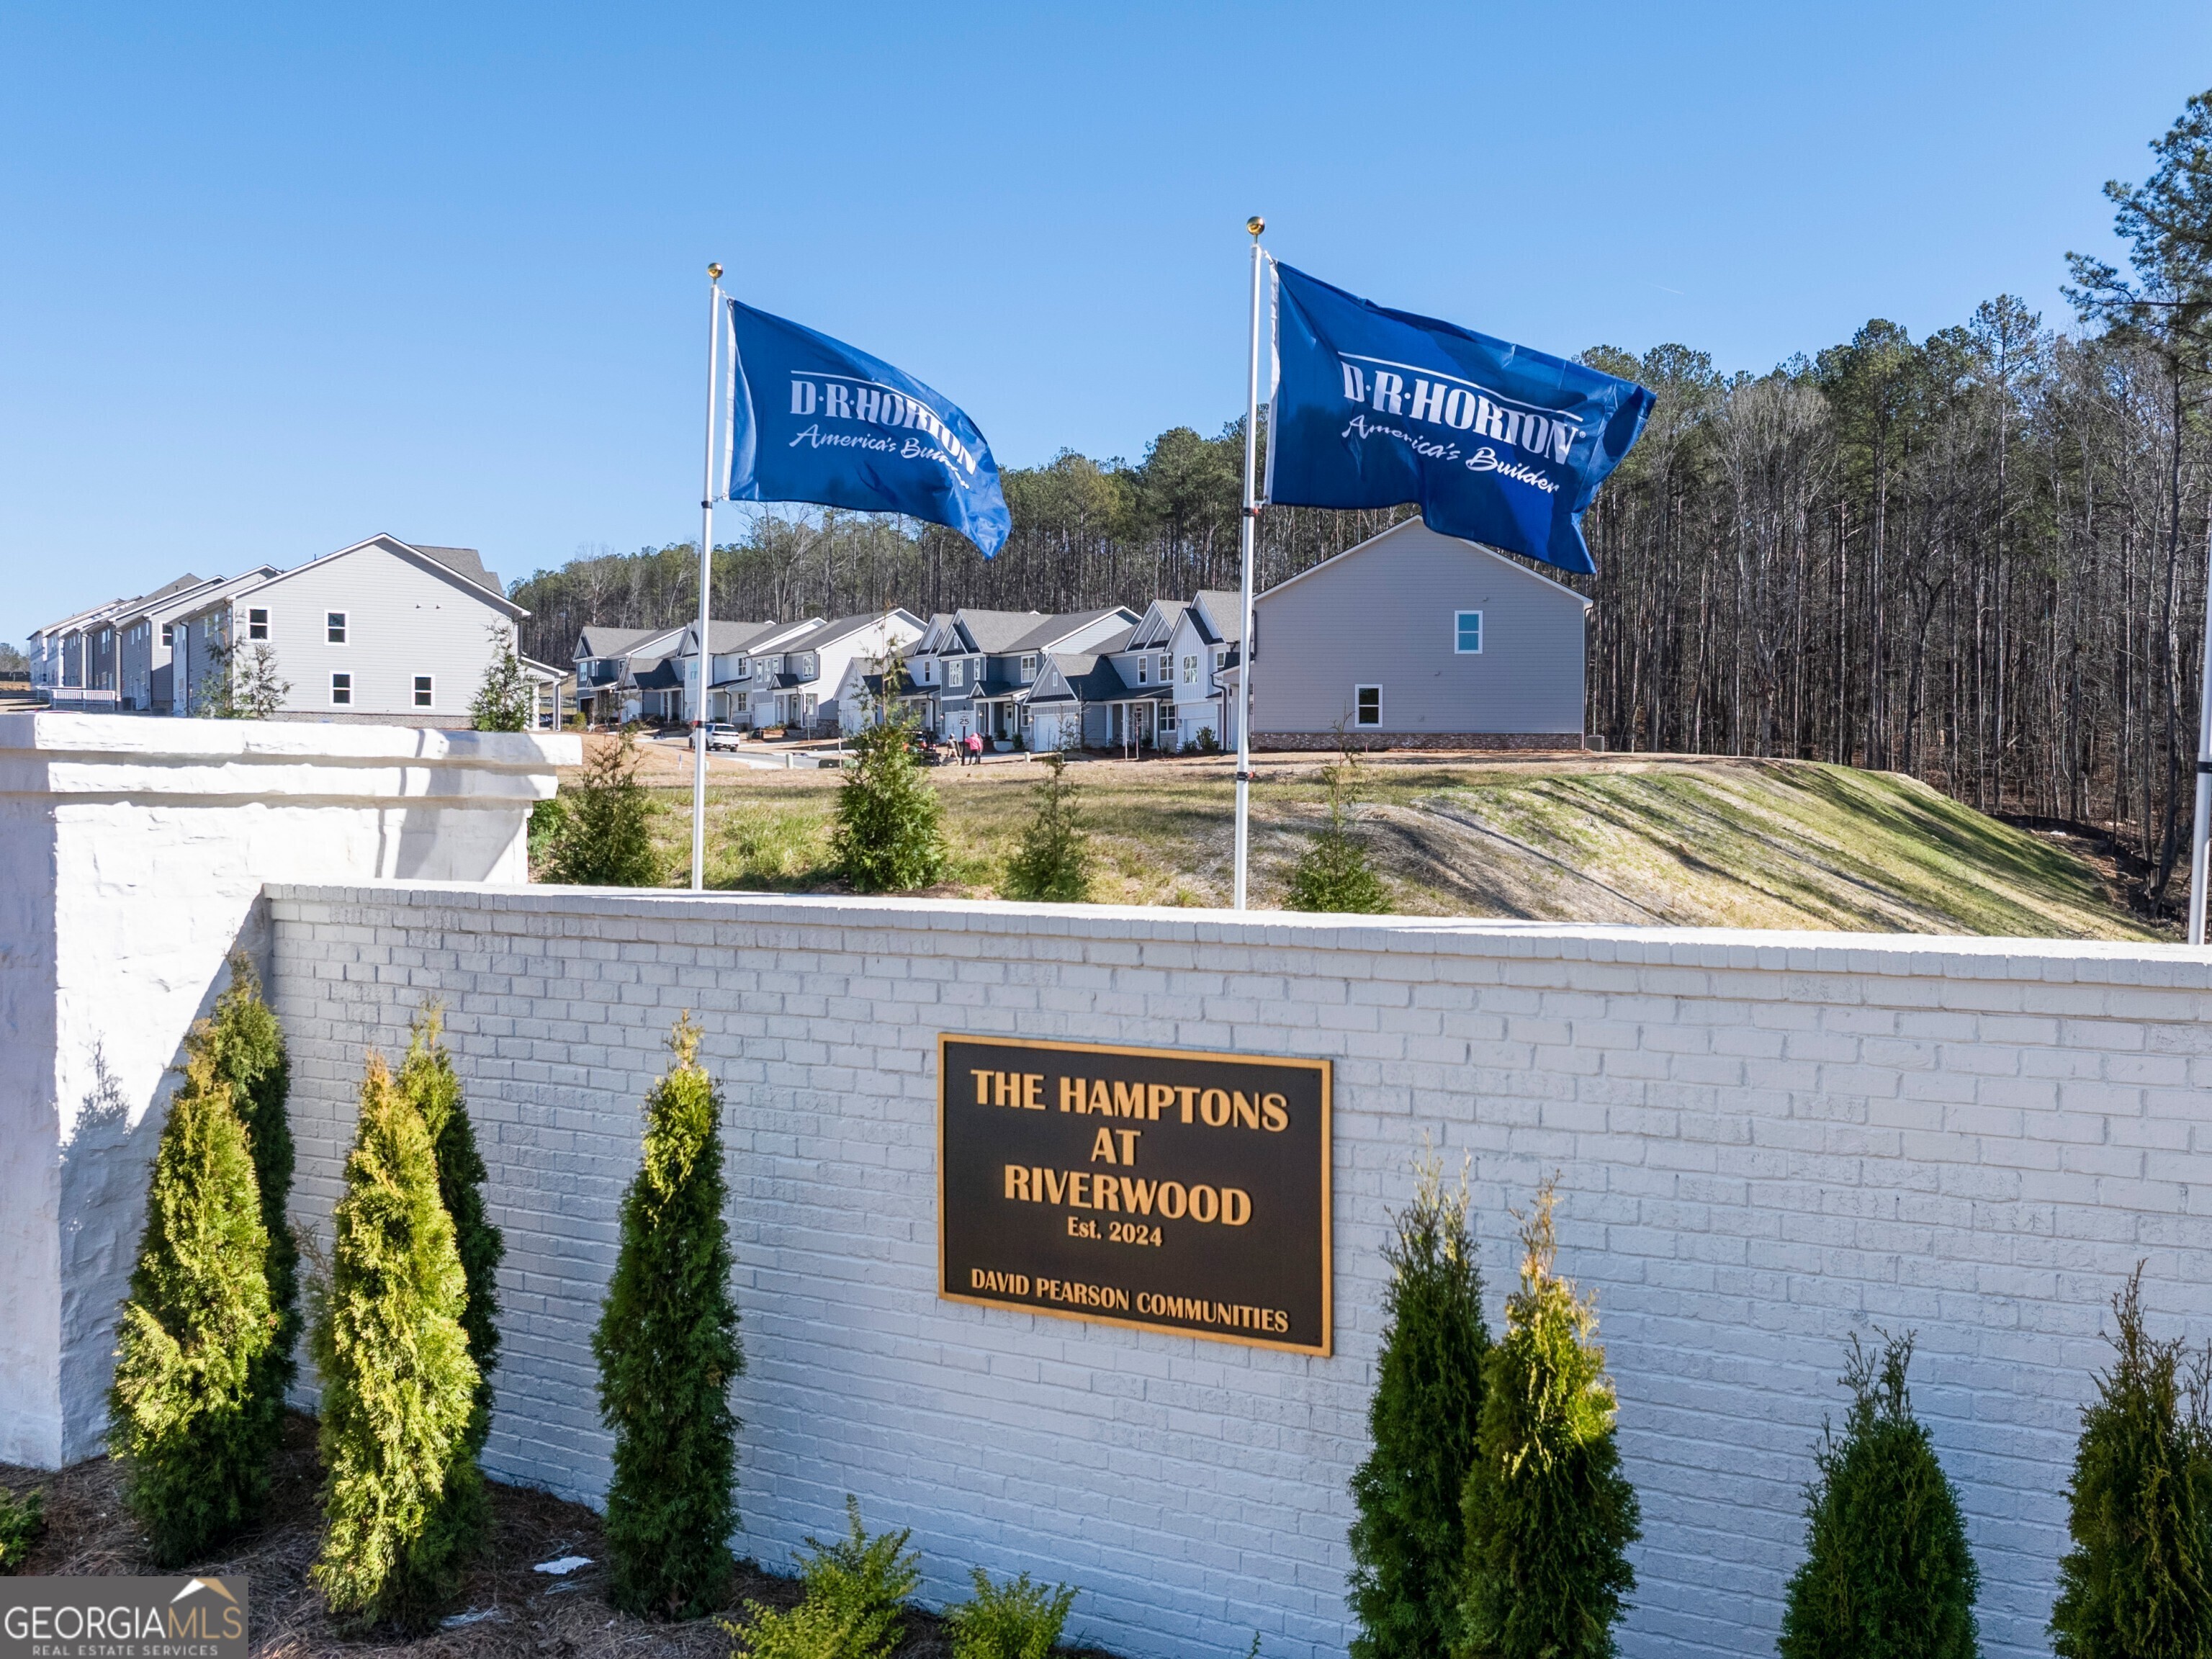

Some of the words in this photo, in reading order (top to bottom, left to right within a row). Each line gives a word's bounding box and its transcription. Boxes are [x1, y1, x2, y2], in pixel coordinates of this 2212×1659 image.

[788, 423, 896, 453] America's
[1341, 414, 1461, 460] America's
[1465, 446, 1560, 494] Builder
[971, 1069, 1046, 1110] THE
[1060, 1076, 1289, 1133] HAMPTONS
[1091, 1127, 1141, 1166] AT
[1004, 1164, 1252, 1226] RIVERWOOD
[1068, 1215, 1102, 1239] Est.
[1109, 1221, 1162, 1247] 2024
[971, 1268, 1030, 1295] DAVID
[1035, 1277, 1130, 1311] PEARSON
[1136, 1292, 1289, 1333] COMMUNITIES
